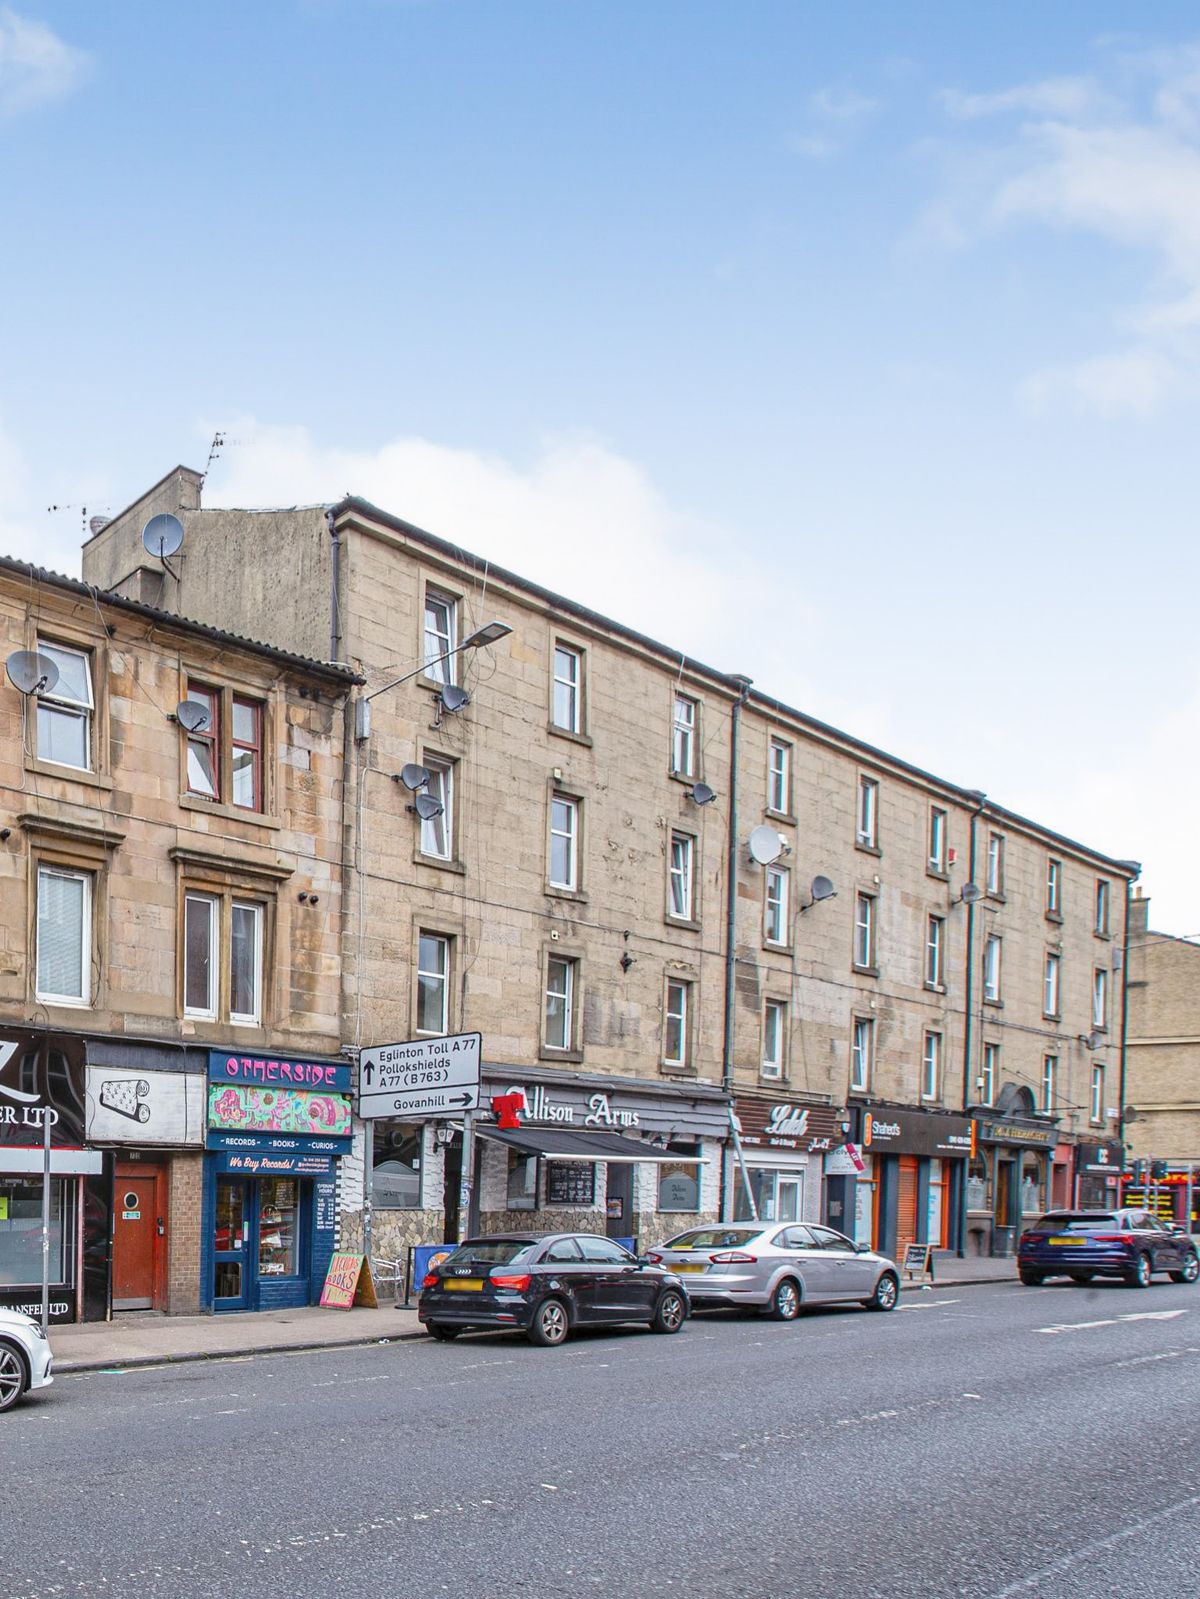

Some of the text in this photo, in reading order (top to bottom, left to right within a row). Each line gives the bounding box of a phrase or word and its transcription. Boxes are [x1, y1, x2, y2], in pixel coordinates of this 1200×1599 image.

[379, 1048, 424, 1063] Eglinton
[427, 1042, 449, 1055] Toll
[226, 1057, 337, 1088] OTHERSIDE
[379, 1057, 451, 1075] Pollokshields
[393, 1095, 446, 1110] Govanhill
[585, 1093, 640, 1127] Arms
[22, 1106, 59, 1128] LTD
[229, 1156, 243, 1167] We
[244, 1157, 260, 1172] Buy
[260, 1158, 295, 1169] Records!
[48, 1302, 69, 1315] LTD
